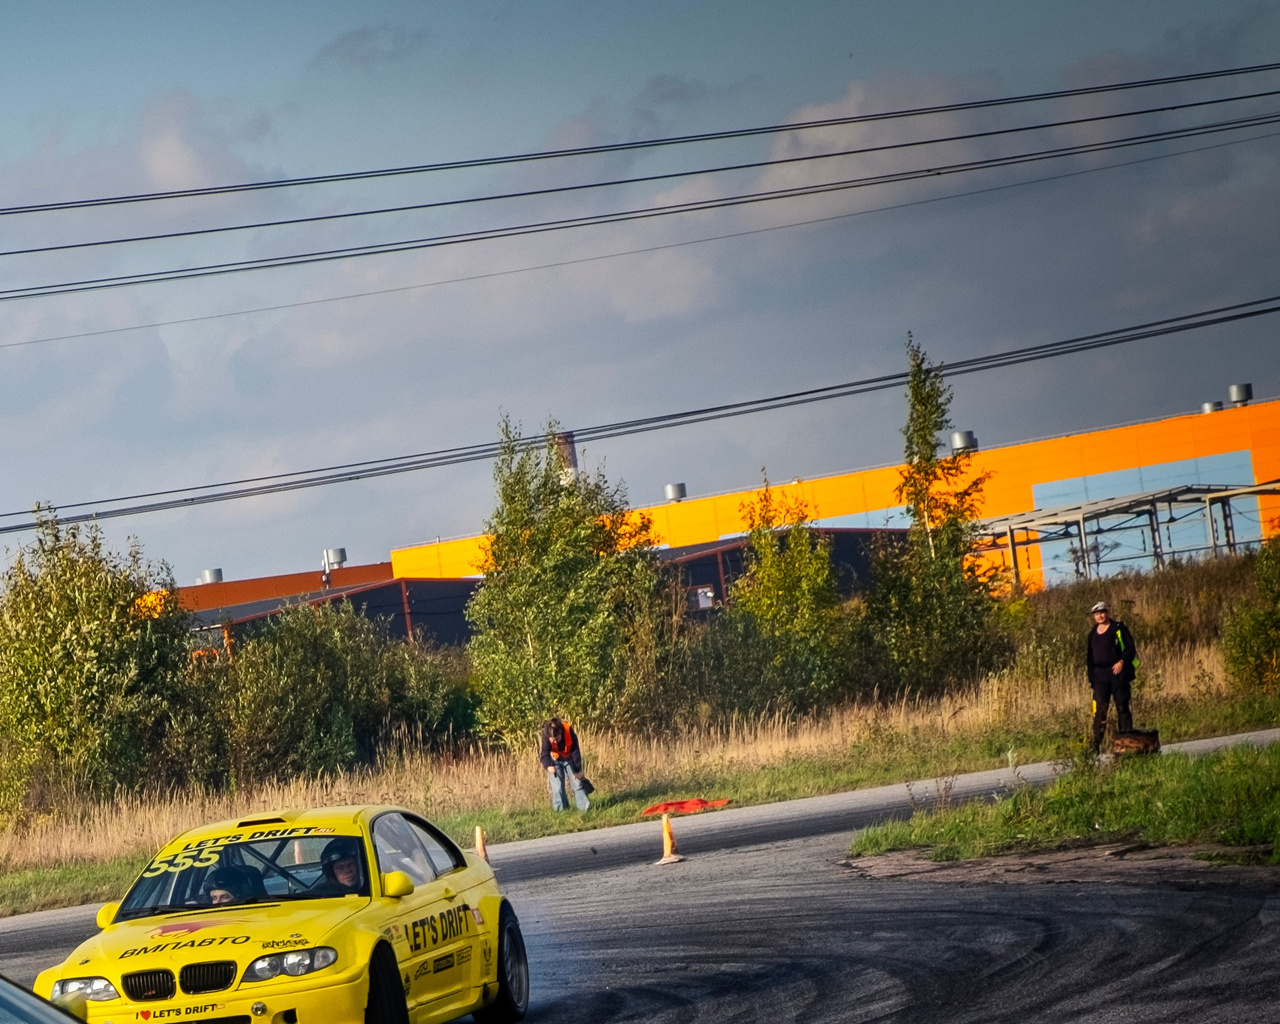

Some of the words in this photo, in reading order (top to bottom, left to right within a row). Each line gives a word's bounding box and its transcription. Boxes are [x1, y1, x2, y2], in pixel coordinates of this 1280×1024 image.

[182, 833, 244, 852] LET'S
[143, 846, 224, 878] 555
[404, 914, 439, 953] LET'S
[118, 936, 251, 960] ВМПАВТО
[152, 1007, 182, 1019] LET'S
